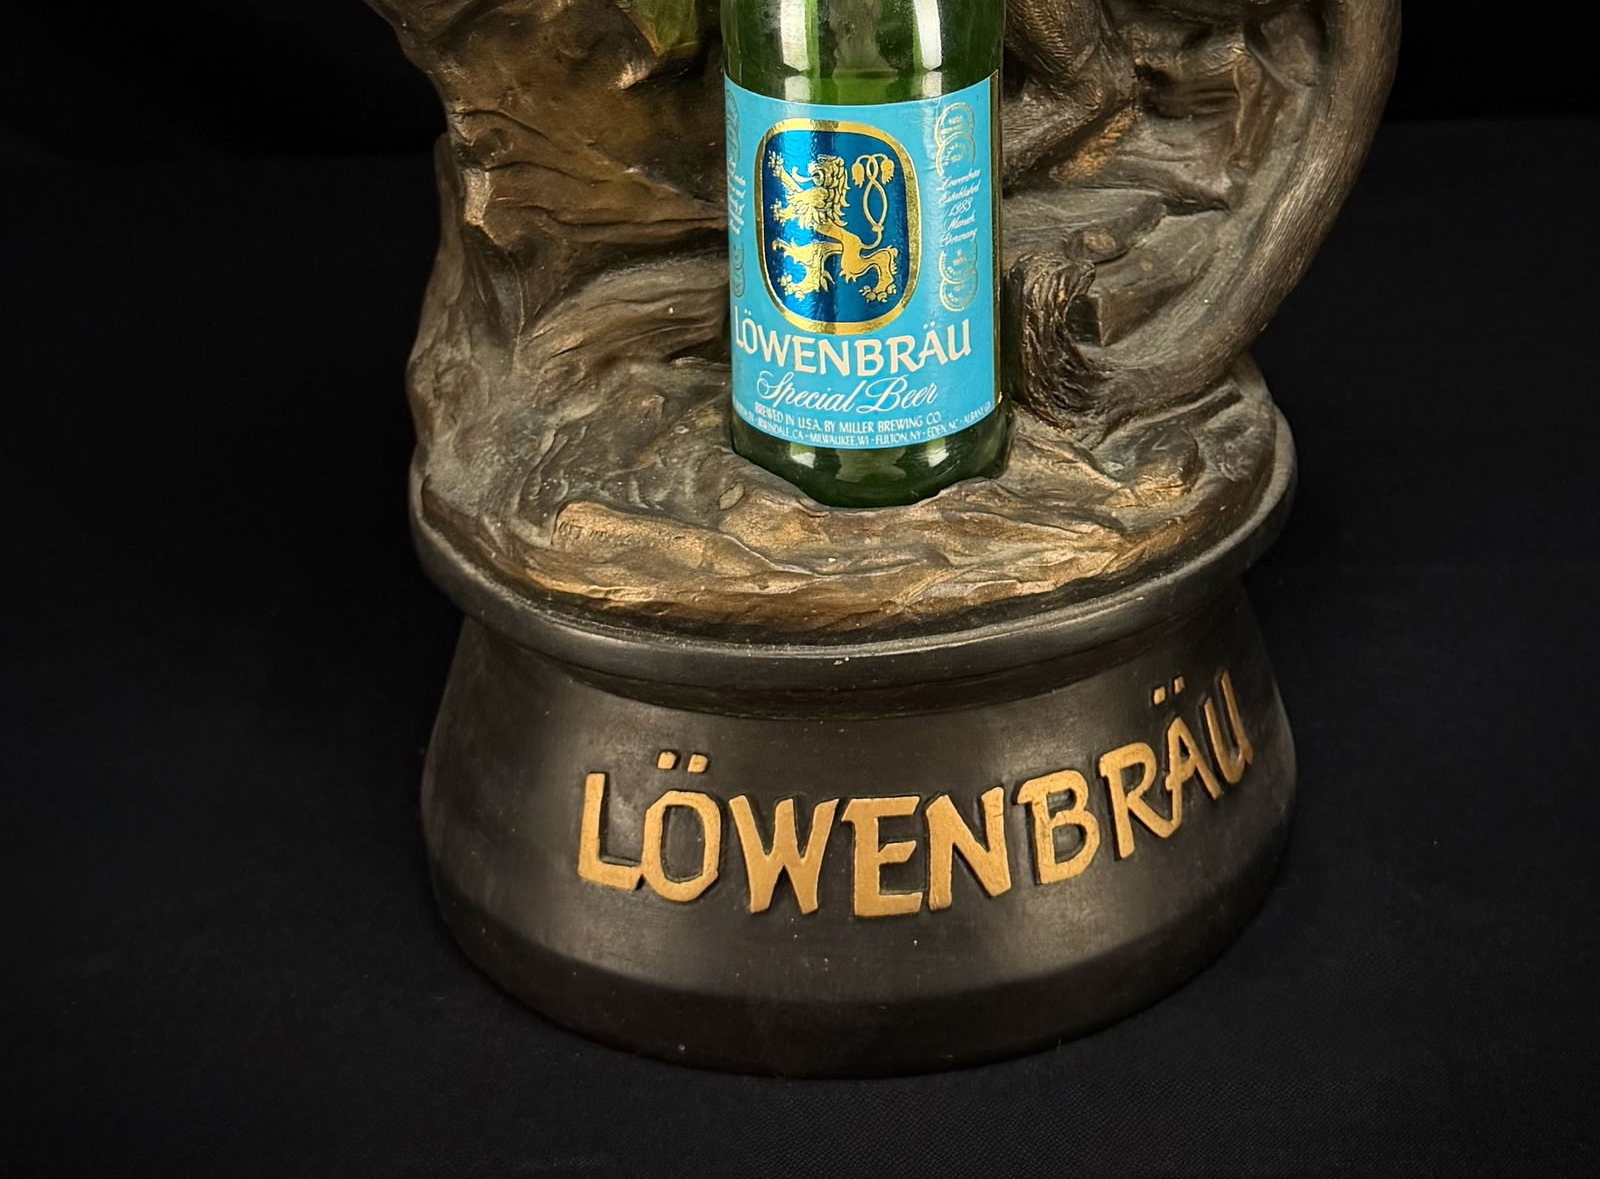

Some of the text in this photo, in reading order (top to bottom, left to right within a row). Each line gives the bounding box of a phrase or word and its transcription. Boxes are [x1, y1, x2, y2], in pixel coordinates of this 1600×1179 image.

[734, 306, 972, 377] LÖWENBRÄU
[757, 370, 867, 413] Special
[856, 374, 938, 415] Beer
[755, 401, 784, 423] BREWED
[785, 413, 795, 426] IN
[823, 420, 836, 433] BY
[839, 420, 875, 435] MILLER
[877, 415, 923, 433] BREWING
[792, 428, 805, 441] CA
[577, 669, 1254, 917] LÖWENBRÄU
